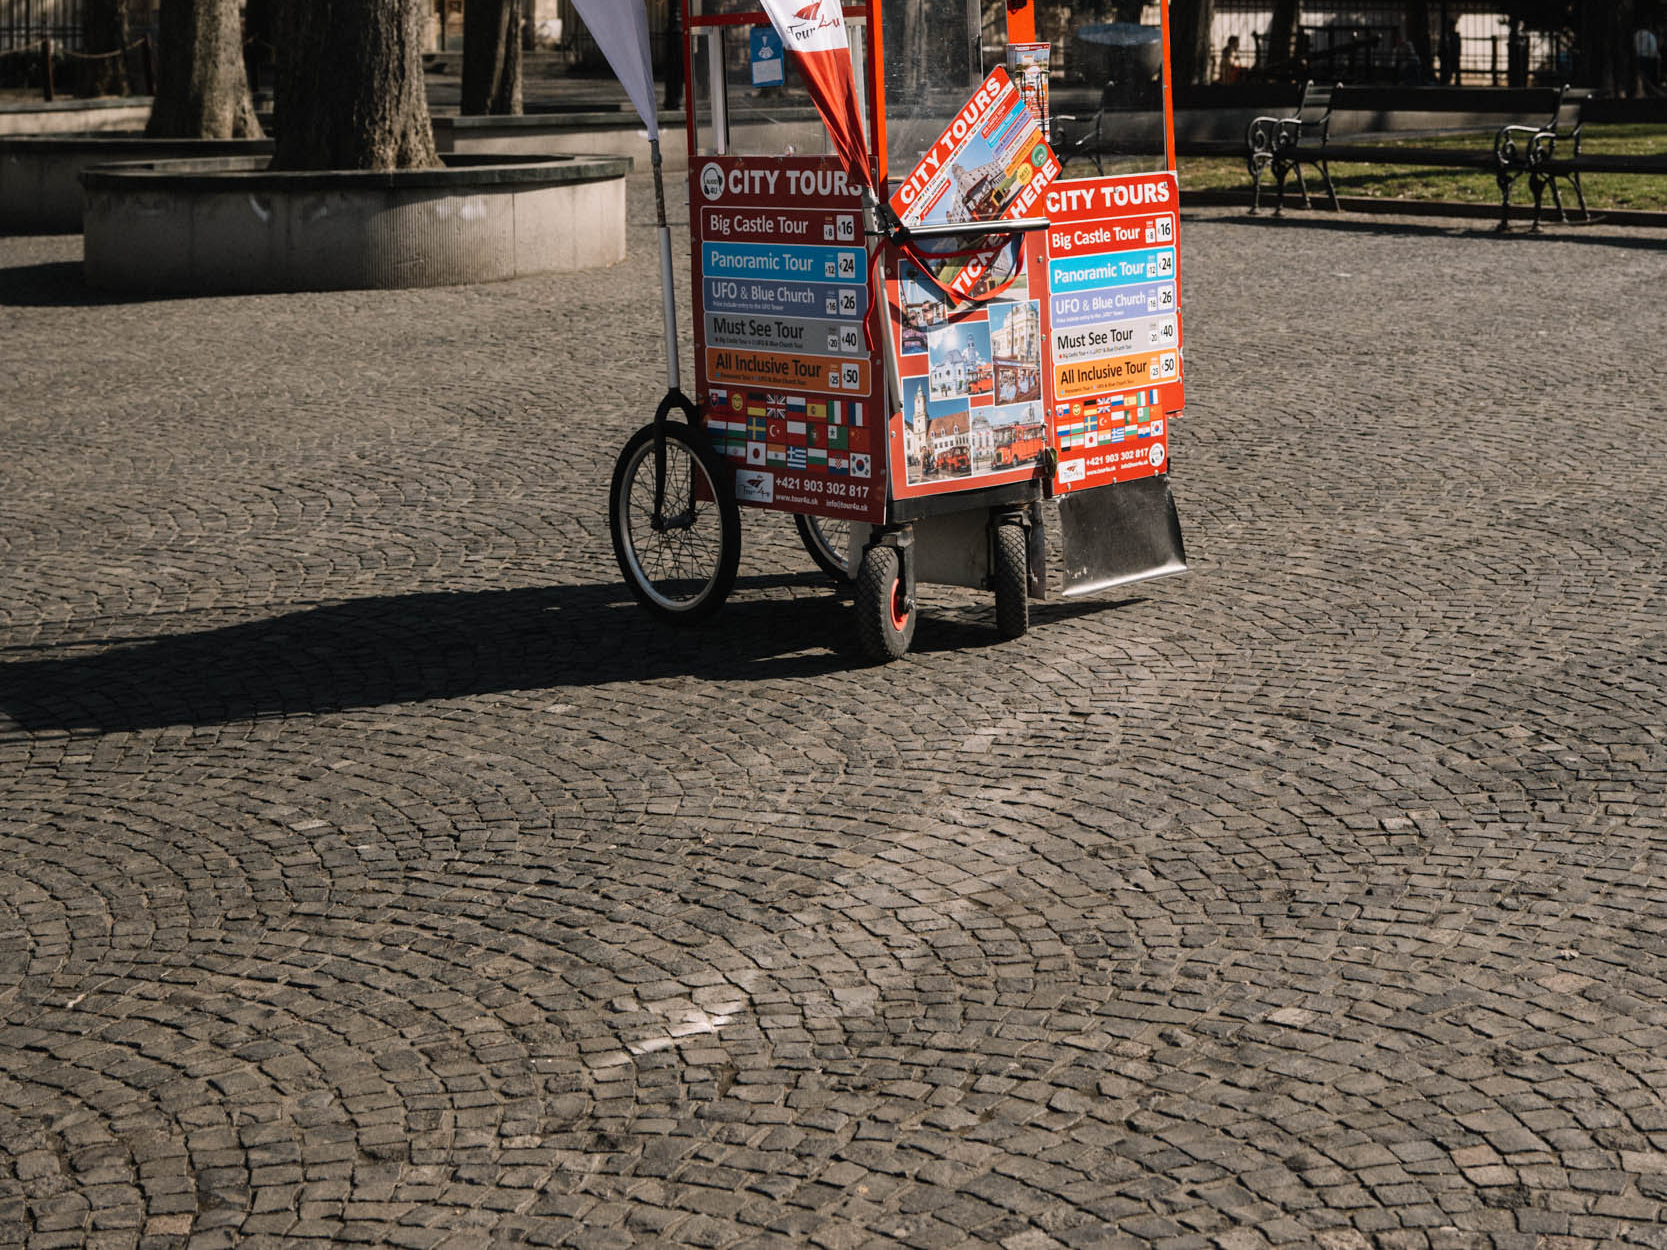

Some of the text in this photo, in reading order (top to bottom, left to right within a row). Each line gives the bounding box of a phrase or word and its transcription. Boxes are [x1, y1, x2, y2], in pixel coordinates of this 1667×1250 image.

[900, 149, 941, 204] CITY
[941, 77, 1001, 150] TOURS
[729, 169, 781, 195] CITY
[1011, 159, 1058, 219] HERE
[1046, 182, 1170, 213] CITY TOURS
[710, 214, 730, 235] Big
[734, 216, 774, 233] Castle
[777, 217, 808, 234] Tour
[1052, 233, 1072, 250] Big
[1074, 228, 1111, 245] Castle
[1113, 227, 1141, 242] Tour
[712, 251, 780, 270] Panoramic
[783, 254, 814, 271] Tour
[1054, 263, 1117, 284] Panoramic
[1119, 261, 1145, 276] Tour
[712, 282, 737, 299] UFO
[740, 287, 749, 300] &
[751, 286, 775, 301] Blue
[777, 287, 814, 303] Church
[1055, 299, 1079, 315] UFO
[1083, 302, 1090, 311] &
[1092, 297, 1113, 309] Blue
[1115, 291, 1146, 307] Church
[714, 318, 746, 334] Must
[749, 320, 772, 337] See
[775, 322, 804, 339] Tour
[1057, 335, 1086, 350] Must
[1088, 332, 1108, 346] See
[1110, 328, 1133, 343] Tour
[716, 353, 732, 369] All
[735, 355, 789, 375] Inclusive
[792, 360, 821, 378] Tour
[1061, 369, 1074, 385] All
[1078, 364, 1122, 382] Inclusive
[1125, 361, 1147, 375] Tour
[1086, 456, 1104, 467] +421
[1105, 453, 1119, 463] 903
[1121, 451, 1134, 461] 302
[1135, 448, 1149, 458] 817
[776, 477, 869, 498] +421 903 302 817
